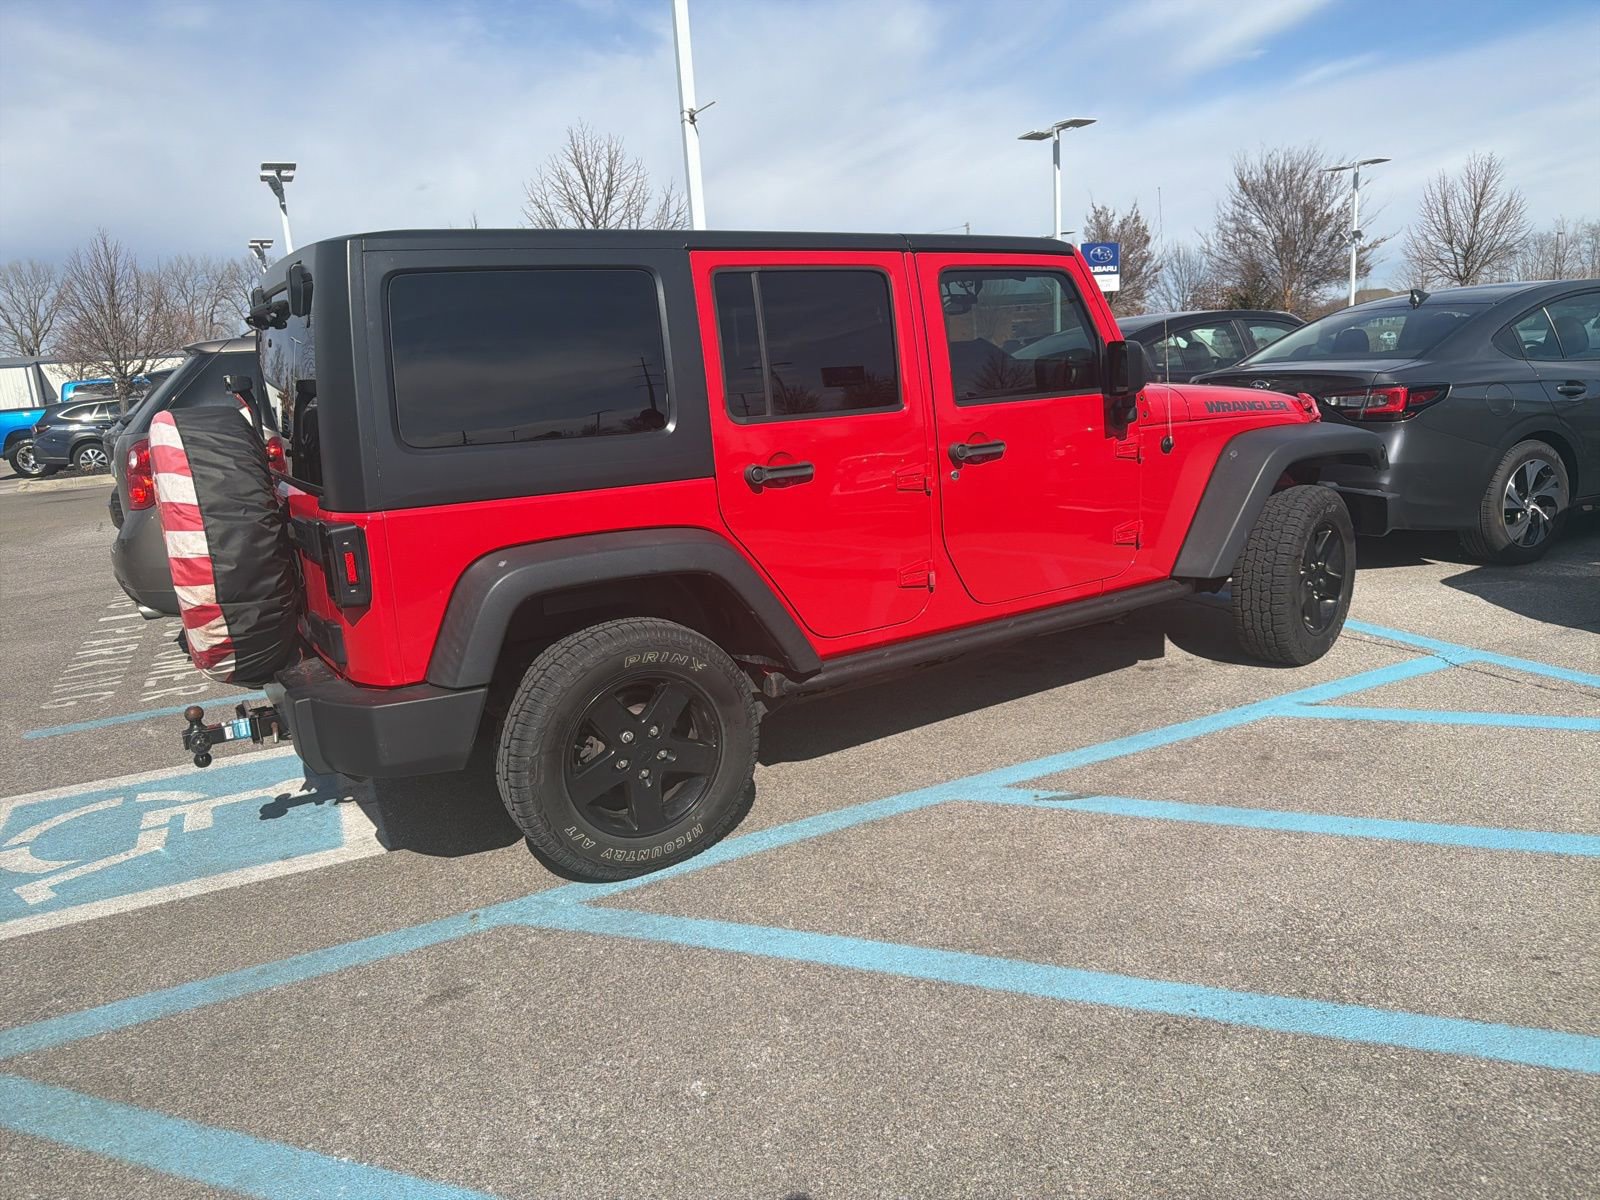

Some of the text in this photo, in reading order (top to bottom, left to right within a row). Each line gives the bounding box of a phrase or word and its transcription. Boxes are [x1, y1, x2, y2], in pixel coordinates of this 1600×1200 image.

[1204, 400, 1290, 413] WRANGLER
[39, 623, 148, 710] PARKING
[624, 651, 708, 672] PRINX
[564, 825, 597, 849] A/T
